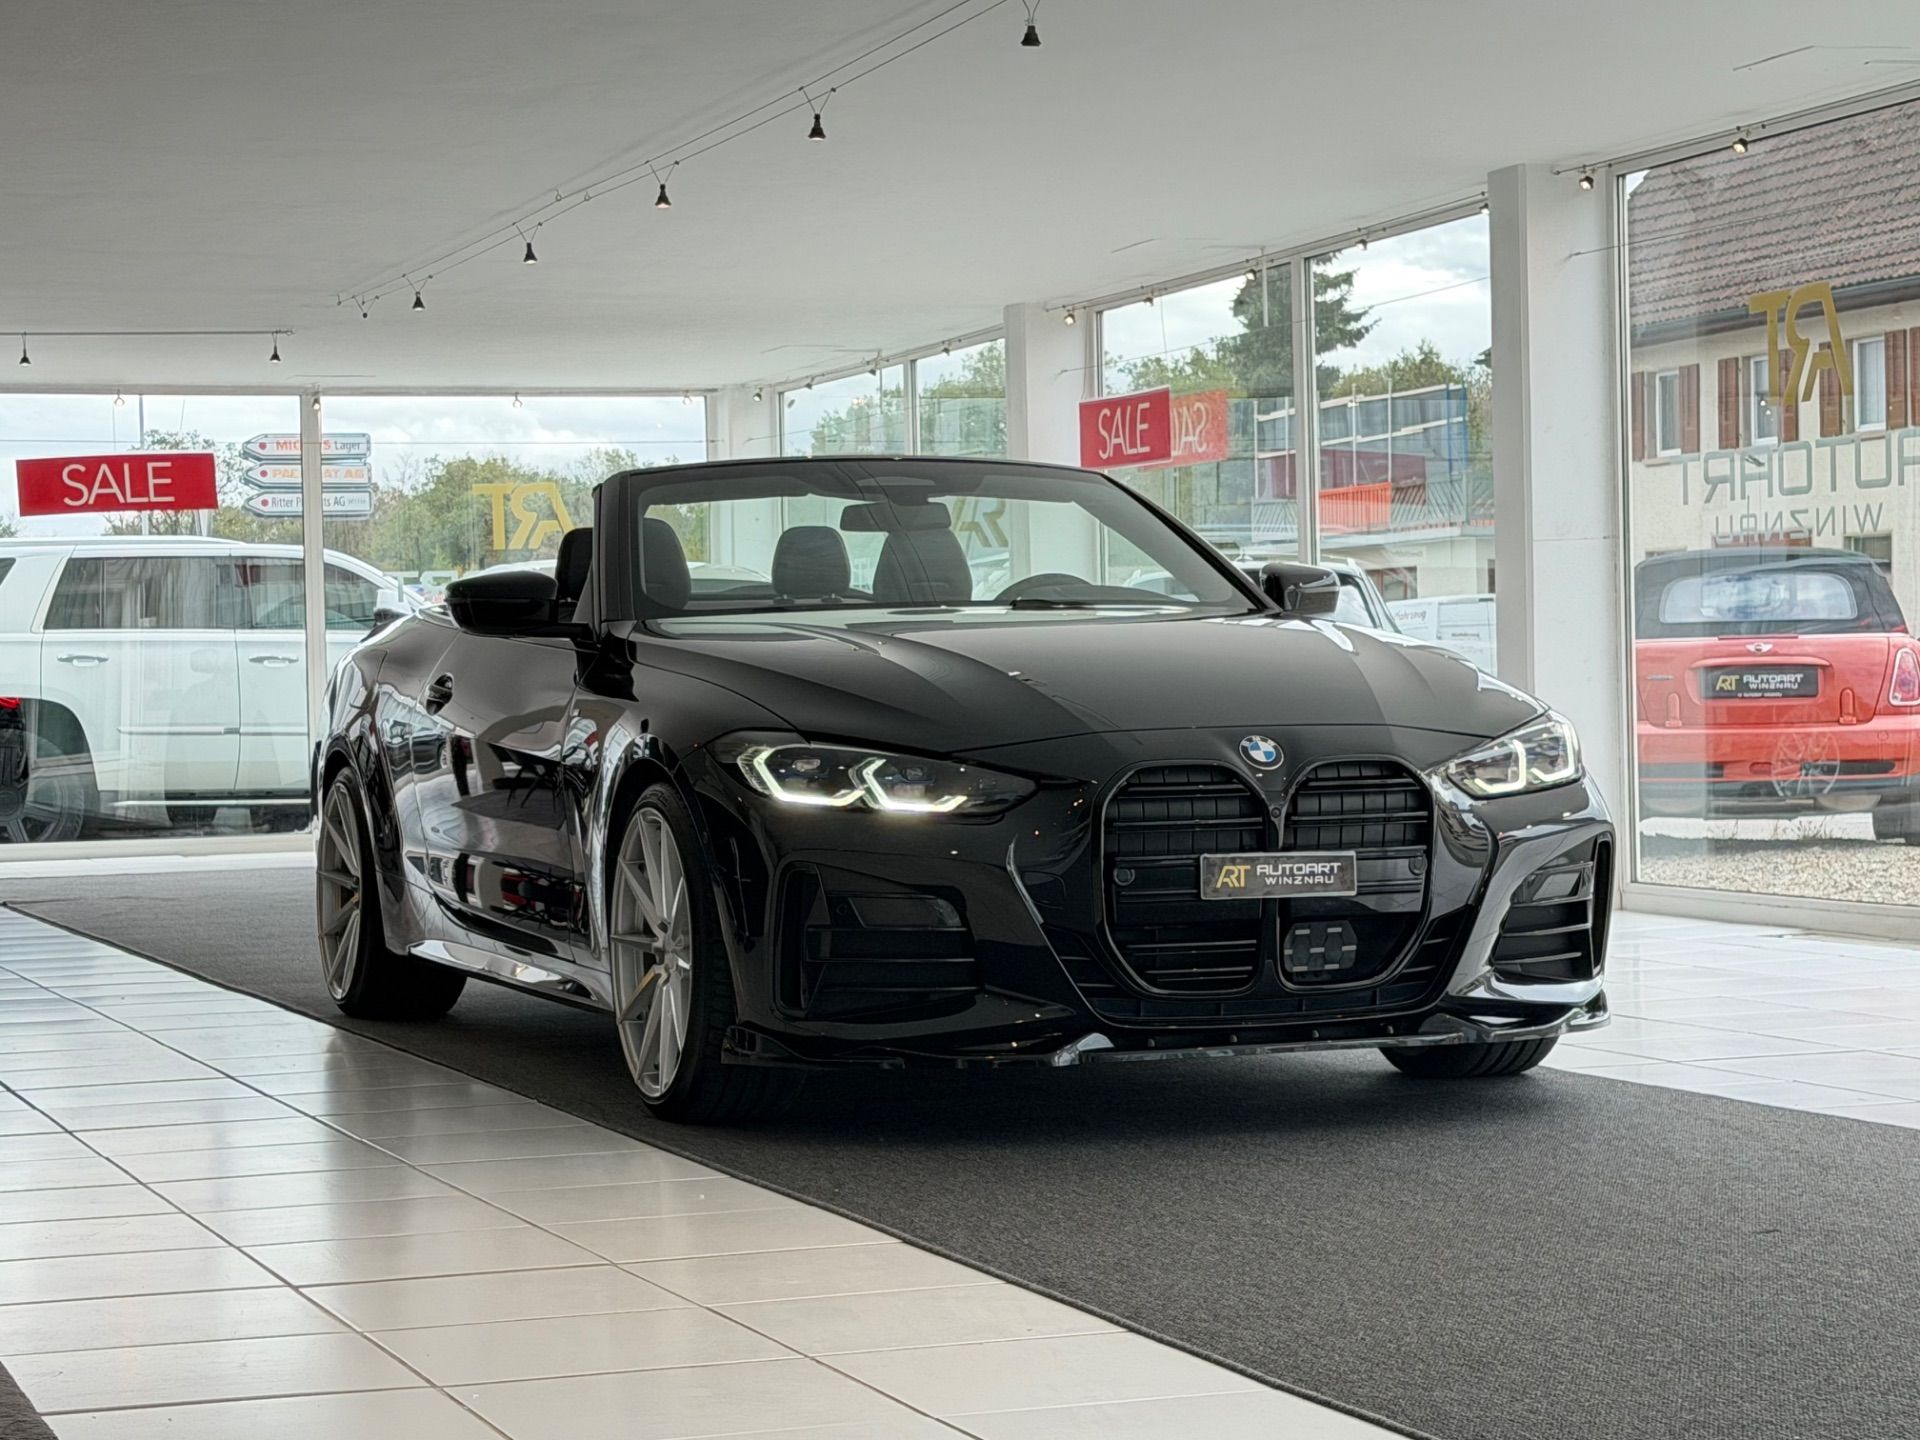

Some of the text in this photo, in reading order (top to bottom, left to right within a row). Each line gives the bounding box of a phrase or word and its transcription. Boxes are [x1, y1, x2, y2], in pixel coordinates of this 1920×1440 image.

[1098, 402, 1151, 460] SALE
[334, 441, 361, 454] Lager
[62, 462, 175, 506] SALE
[271, 497, 293, 508] Ritter
[333, 496, 346, 507] AG
[1715, 674, 1804, 691] ART AUTOART
[1216, 862, 1341, 889] ART AUTOART
[1265, 876, 1334, 885] WINZNAU
